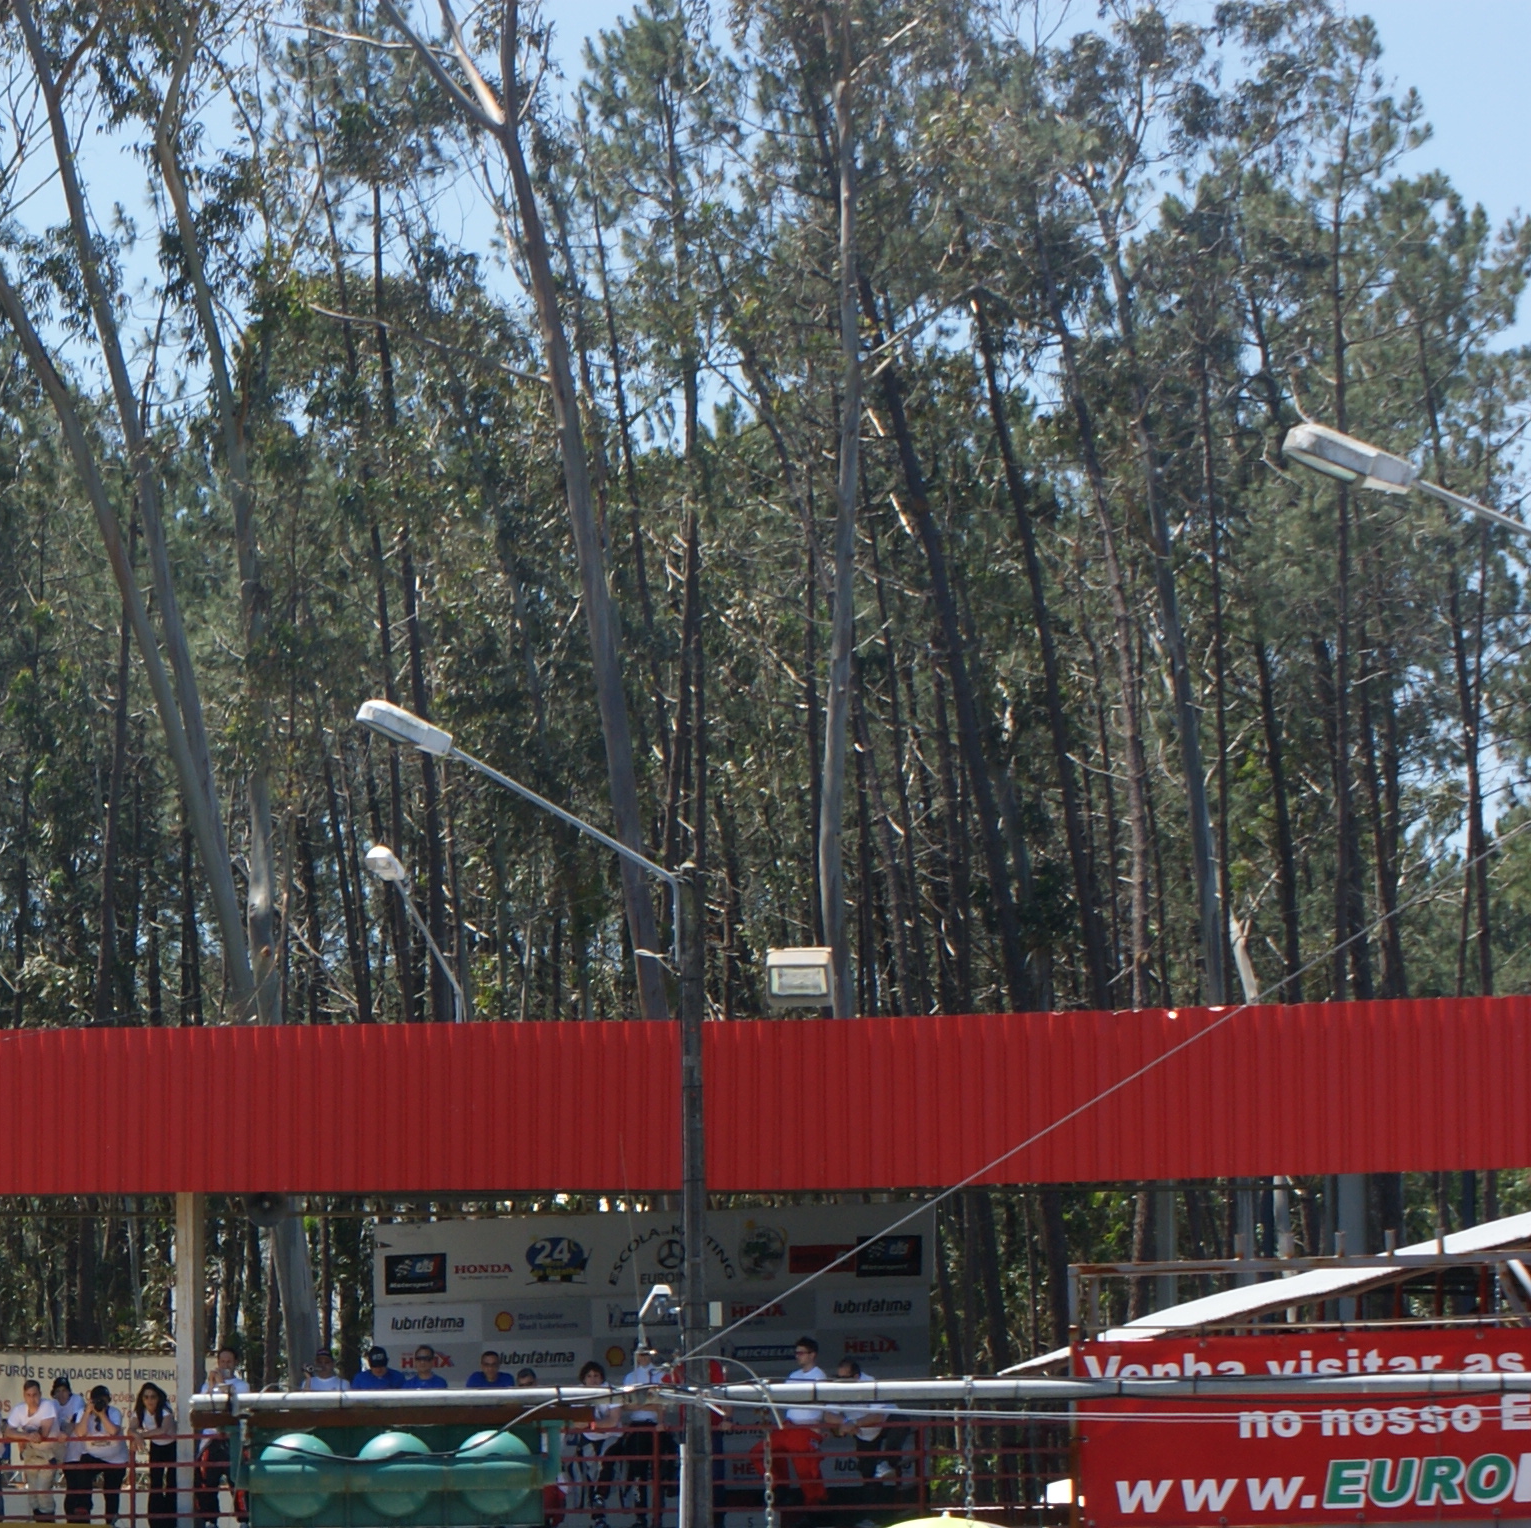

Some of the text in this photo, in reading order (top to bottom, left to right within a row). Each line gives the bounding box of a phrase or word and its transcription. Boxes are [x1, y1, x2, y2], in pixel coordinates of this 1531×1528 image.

[534, 1239, 571, 1264] 24
[454, 1263, 513, 1274] HONDA
[844, 1339, 899, 1353] HELIX
[0, 1364, 34, 1378] FUROS
[38, 1366, 44, 1379] E
[47, 1367, 113, 1380] SONDAGENS
[116, 1368, 130, 1380] DE
[1239, 1408, 1302, 1439] no
[1322, 1404, 1482, 1437] nosso
